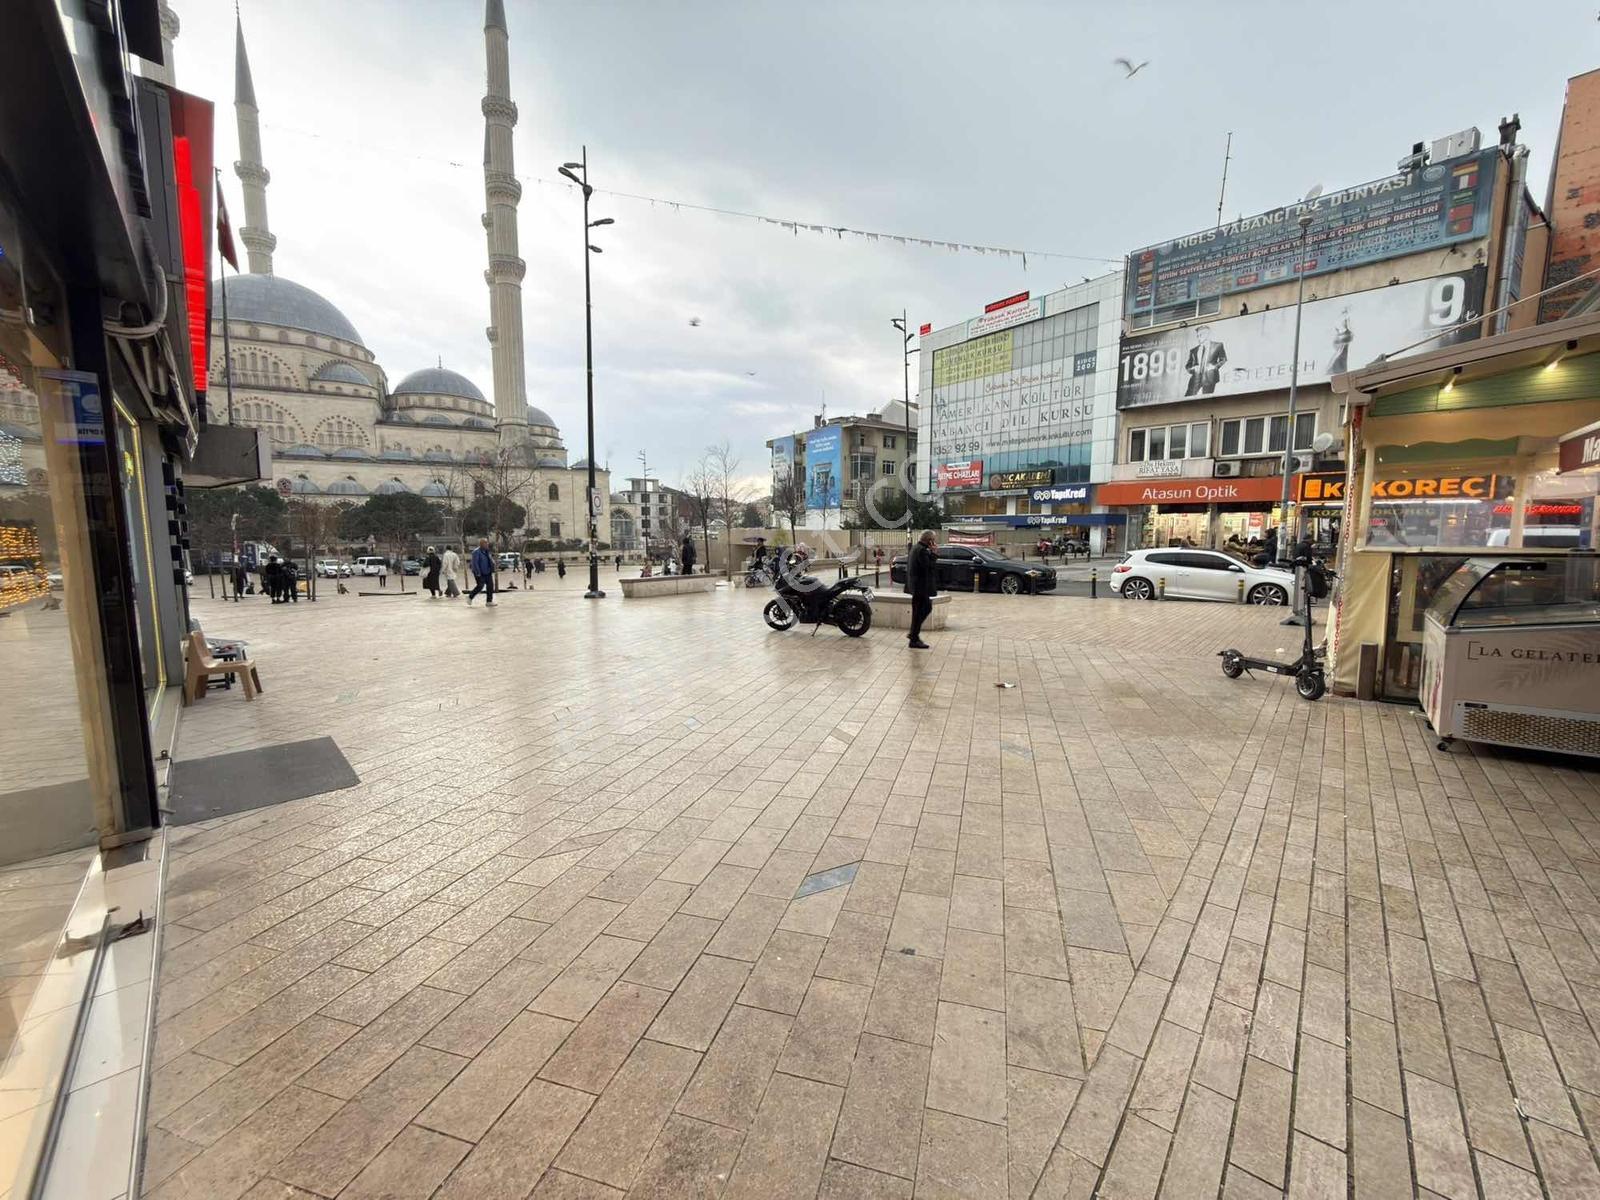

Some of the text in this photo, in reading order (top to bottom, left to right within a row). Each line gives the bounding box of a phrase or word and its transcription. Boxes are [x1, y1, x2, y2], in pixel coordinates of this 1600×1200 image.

[1221, 211, 1289, 236] YABANCI
[1121, 348, 1181, 381] 1899
[1041, 404, 1094, 422] KURSU
[1142, 485, 1239, 500] Atasun Optik
[1480, 646, 1503, 657] LA
